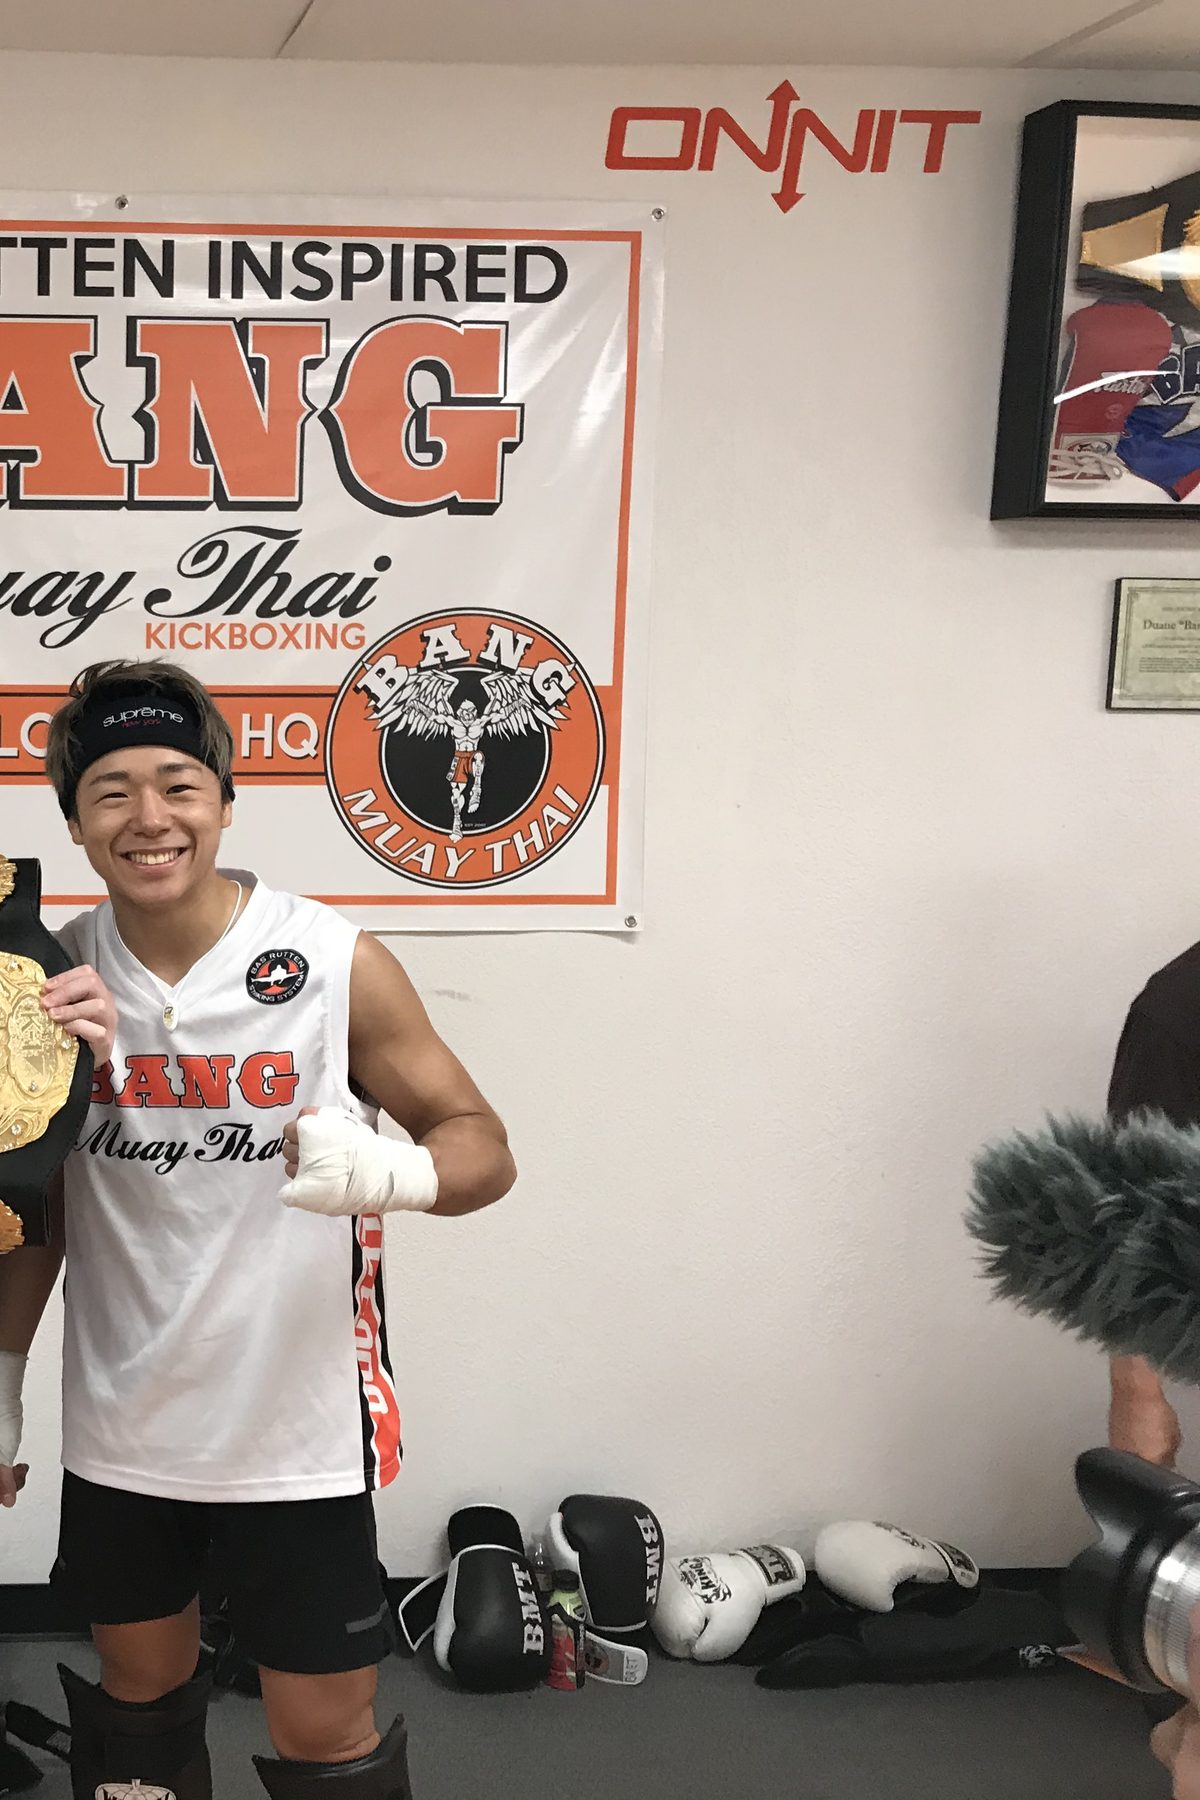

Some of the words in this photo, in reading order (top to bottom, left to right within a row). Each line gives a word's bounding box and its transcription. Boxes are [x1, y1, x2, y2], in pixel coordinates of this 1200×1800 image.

[605, 84, 982, 206] ONNIT
[208, 240, 568, 303] INSPIRED
[145, 525, 392, 618] Thai
[145, 622, 366, 650] KICKBOXING
[1143, 619, 1177, 630] Duane
[353, 623, 580, 714] BANG
[241, 712, 319, 759] HQ
[342, 788, 475, 878] MUAY
[486, 785, 580, 874] THAI
[251, 956, 266, 974] BAS
[269, 952, 304, 969] RUTTEN
[74, 1120, 189, 1176] Muay
[194, 1123, 286, 1163] Tha
[634, 1514, 661, 1604] BMT
[689, 1559, 716, 1590] KING
[511, 1562, 544, 1655] BMT
